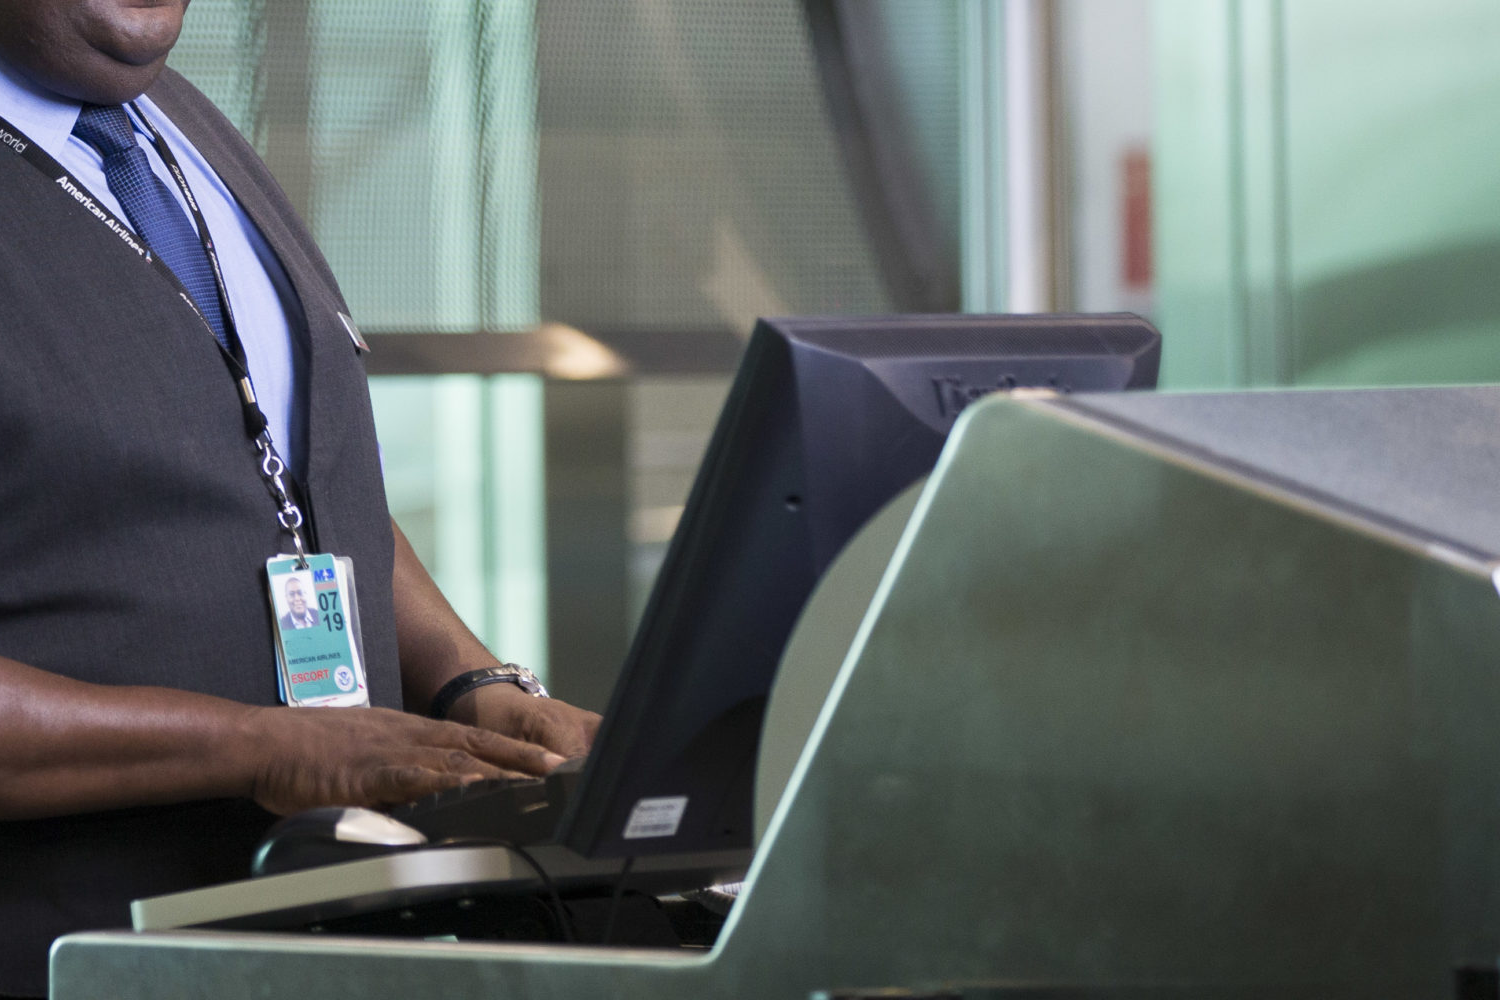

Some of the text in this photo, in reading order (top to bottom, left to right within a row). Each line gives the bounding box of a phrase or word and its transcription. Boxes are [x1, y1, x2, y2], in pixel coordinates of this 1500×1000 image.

[55, 175, 146, 257] American Airlines
[318, 591, 338, 612] 07
[323, 612, 344, 633] 19
[291, 669, 330, 685] ESCORT
